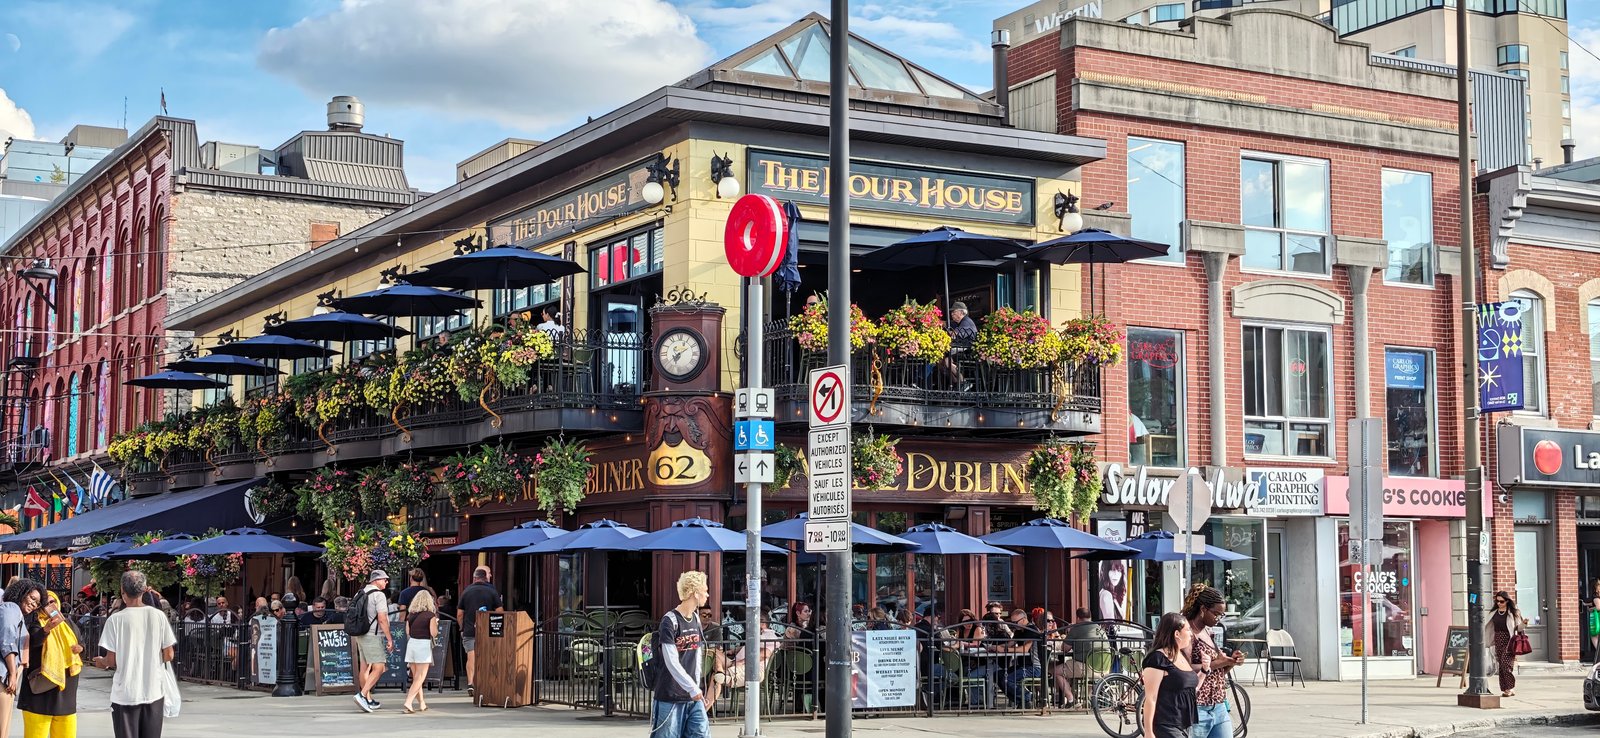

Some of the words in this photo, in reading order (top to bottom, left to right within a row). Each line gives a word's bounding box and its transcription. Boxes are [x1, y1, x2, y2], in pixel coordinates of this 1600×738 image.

[759, 160, 820, 193] THE
[823, 166, 918, 205] OUR
[919, 177, 1023, 212] HOUSE
[513, 218, 537, 241] THE
[537, 203, 575, 237] POUR
[577, 182, 627, 220] HOUSE
[1392, 363, 1418, 371] GRAPHICS
[817, 432, 839, 444] EXCEPT
[811, 444, 847, 457] AUTHORIZED
[655, 456, 697, 480] 62
[814, 458, 843, 470] VEHICLES
[585, 458, 645, 495] BLINER
[906, 452, 1036, 494] DUBLIN
[1268, 471, 1307, 482] CARLOS
[814, 478, 829, 489] SAUF
[831, 477, 843, 488] LES
[1268, 483, 1319, 494] GRAPHICS
[813, 490, 845, 502] VÉHICULES
[1268, 494, 1319, 505] PRINTING
[813, 501, 845, 516] AUTORISÉS
[1131, 511, 1145, 524] WE
[1130, 525, 1145, 537] DO
[807, 531, 814, 544] 7
[319, 630, 339, 641] LIVE
[323, 637, 348, 648] MUSIC
